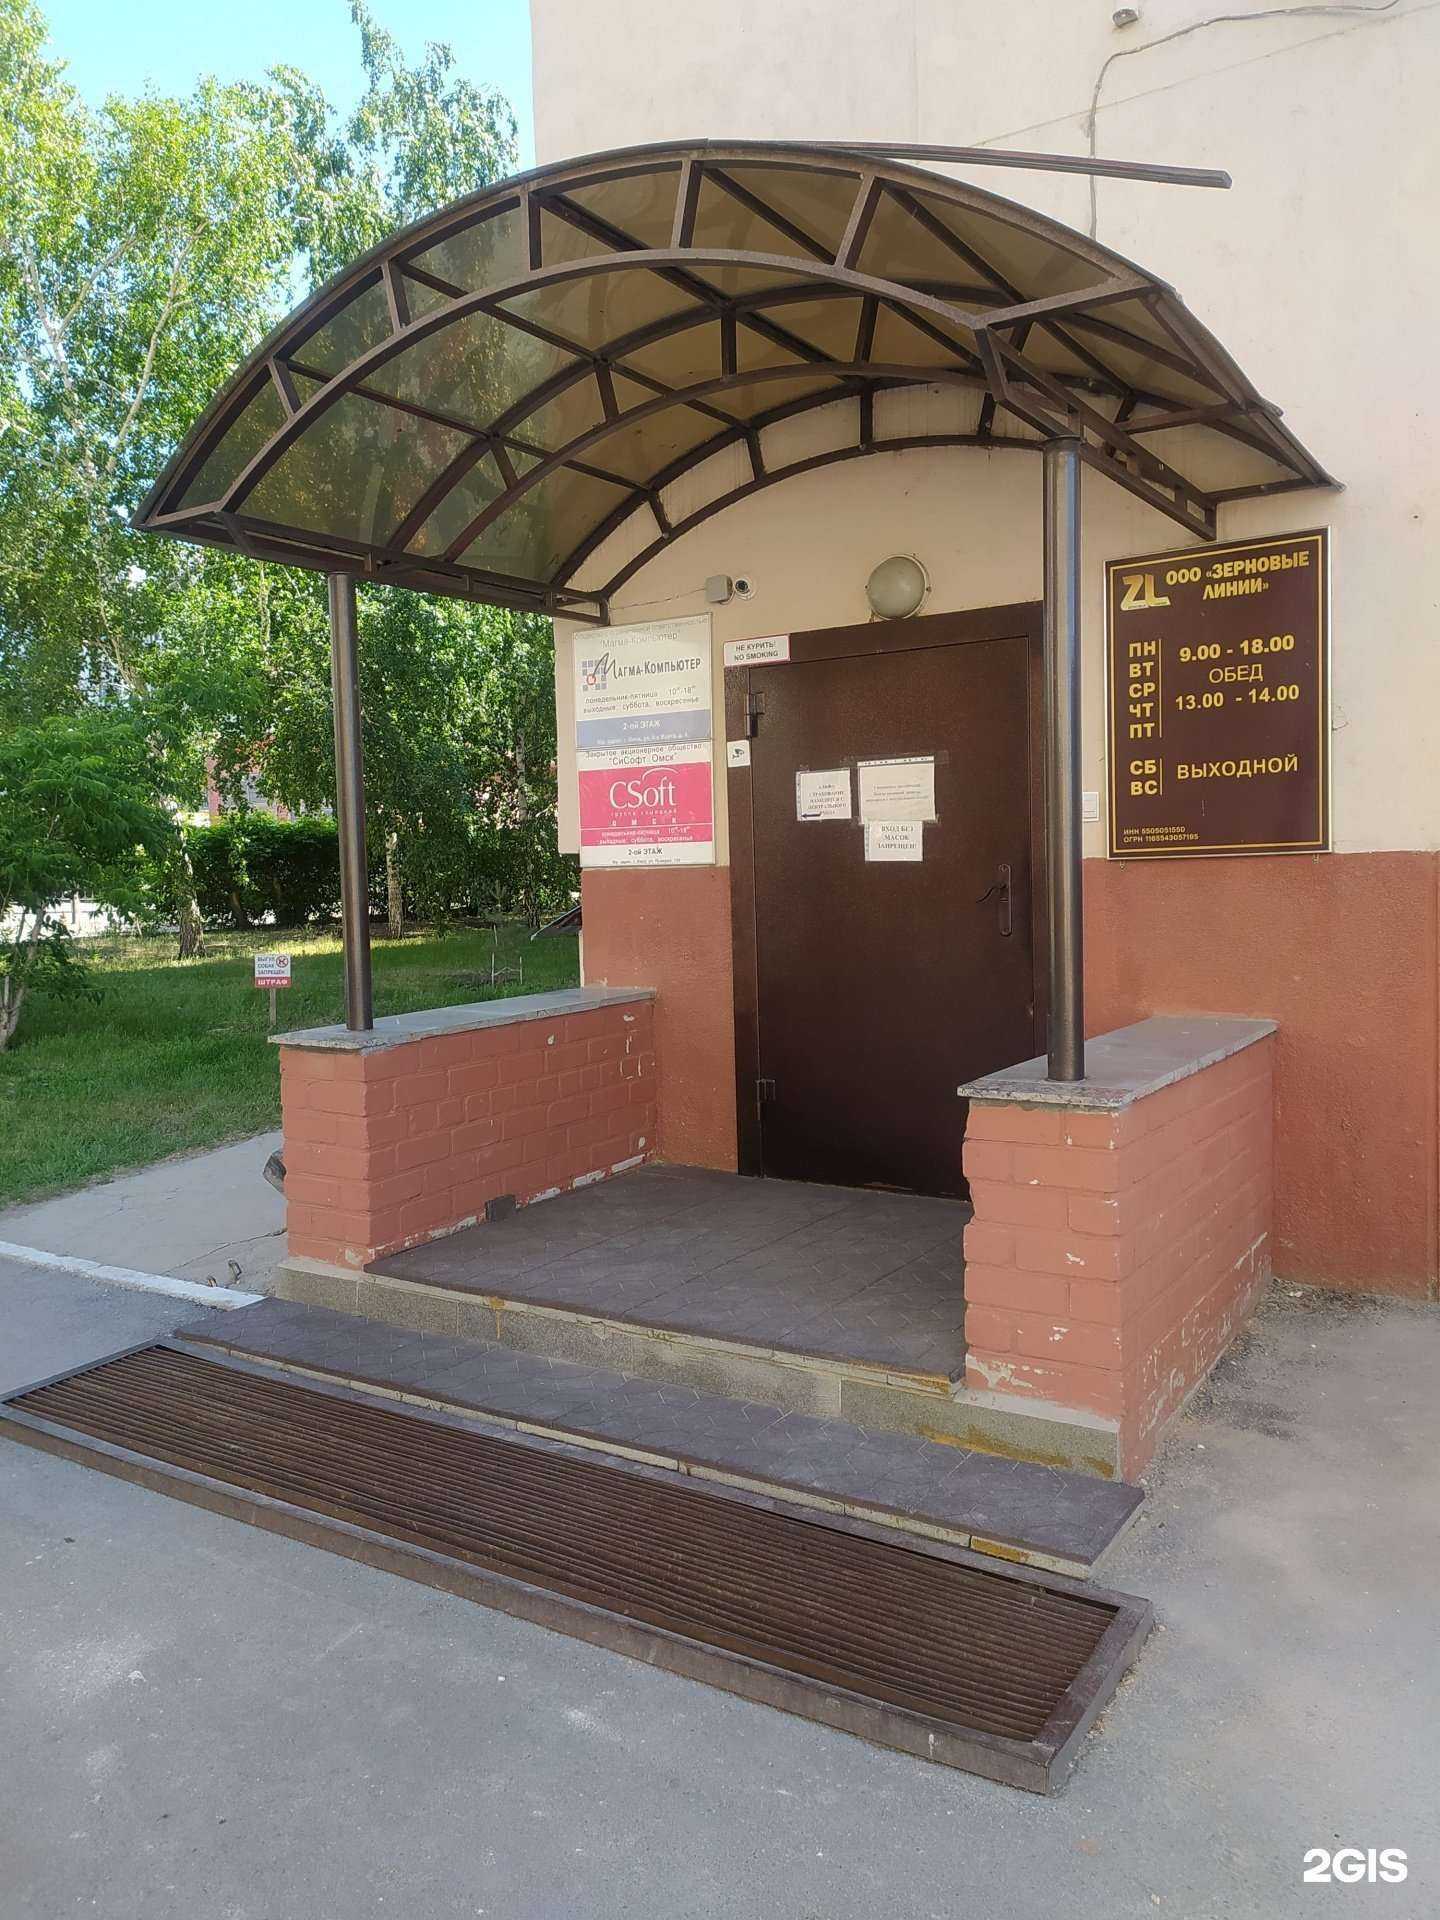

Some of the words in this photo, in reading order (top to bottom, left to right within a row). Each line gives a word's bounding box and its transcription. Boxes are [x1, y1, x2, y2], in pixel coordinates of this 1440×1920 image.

[1166, 567, 1201, 585] ООО
[1206, 551, 1309, 578] «ЗЕРНОВЫЕ
[1121, 574, 1171, 611] ZL
[1203, 577, 1269, 600] ЛИНИИ»
[735, 643, 746, 652] НЕ
[1129, 641, 1156, 657] ПН
[1179, 643, 1221, 662] 9.00
[1240, 635, 1295, 656] 18.00
[734, 653, 745, 662] NO
[746, 650, 779, 660] SMOKING
[1129, 662, 1154, 677] ВТ
[1208, 663, 1264, 684] ОБЕД
[1128, 682, 1156, 698] СР
[1175, 692, 1224, 711] 13.00
[1248, 684, 1300, 704] 14.00
[1129, 702, 1154, 718] ЧТ
[1129, 722, 1155, 739] ПТ
[1129, 760, 1157, 776] СБ
[1177, 753, 1298, 780] ВЫХОДНОЙ
[609, 776, 677, 809] CSoft
[1130, 780, 1158, 796] ВС
[1123, 828, 1140, 836] ИНН
[1123, 835, 1143, 843] ОГРН
[643, 846, 663, 855] ЭТАЖ
